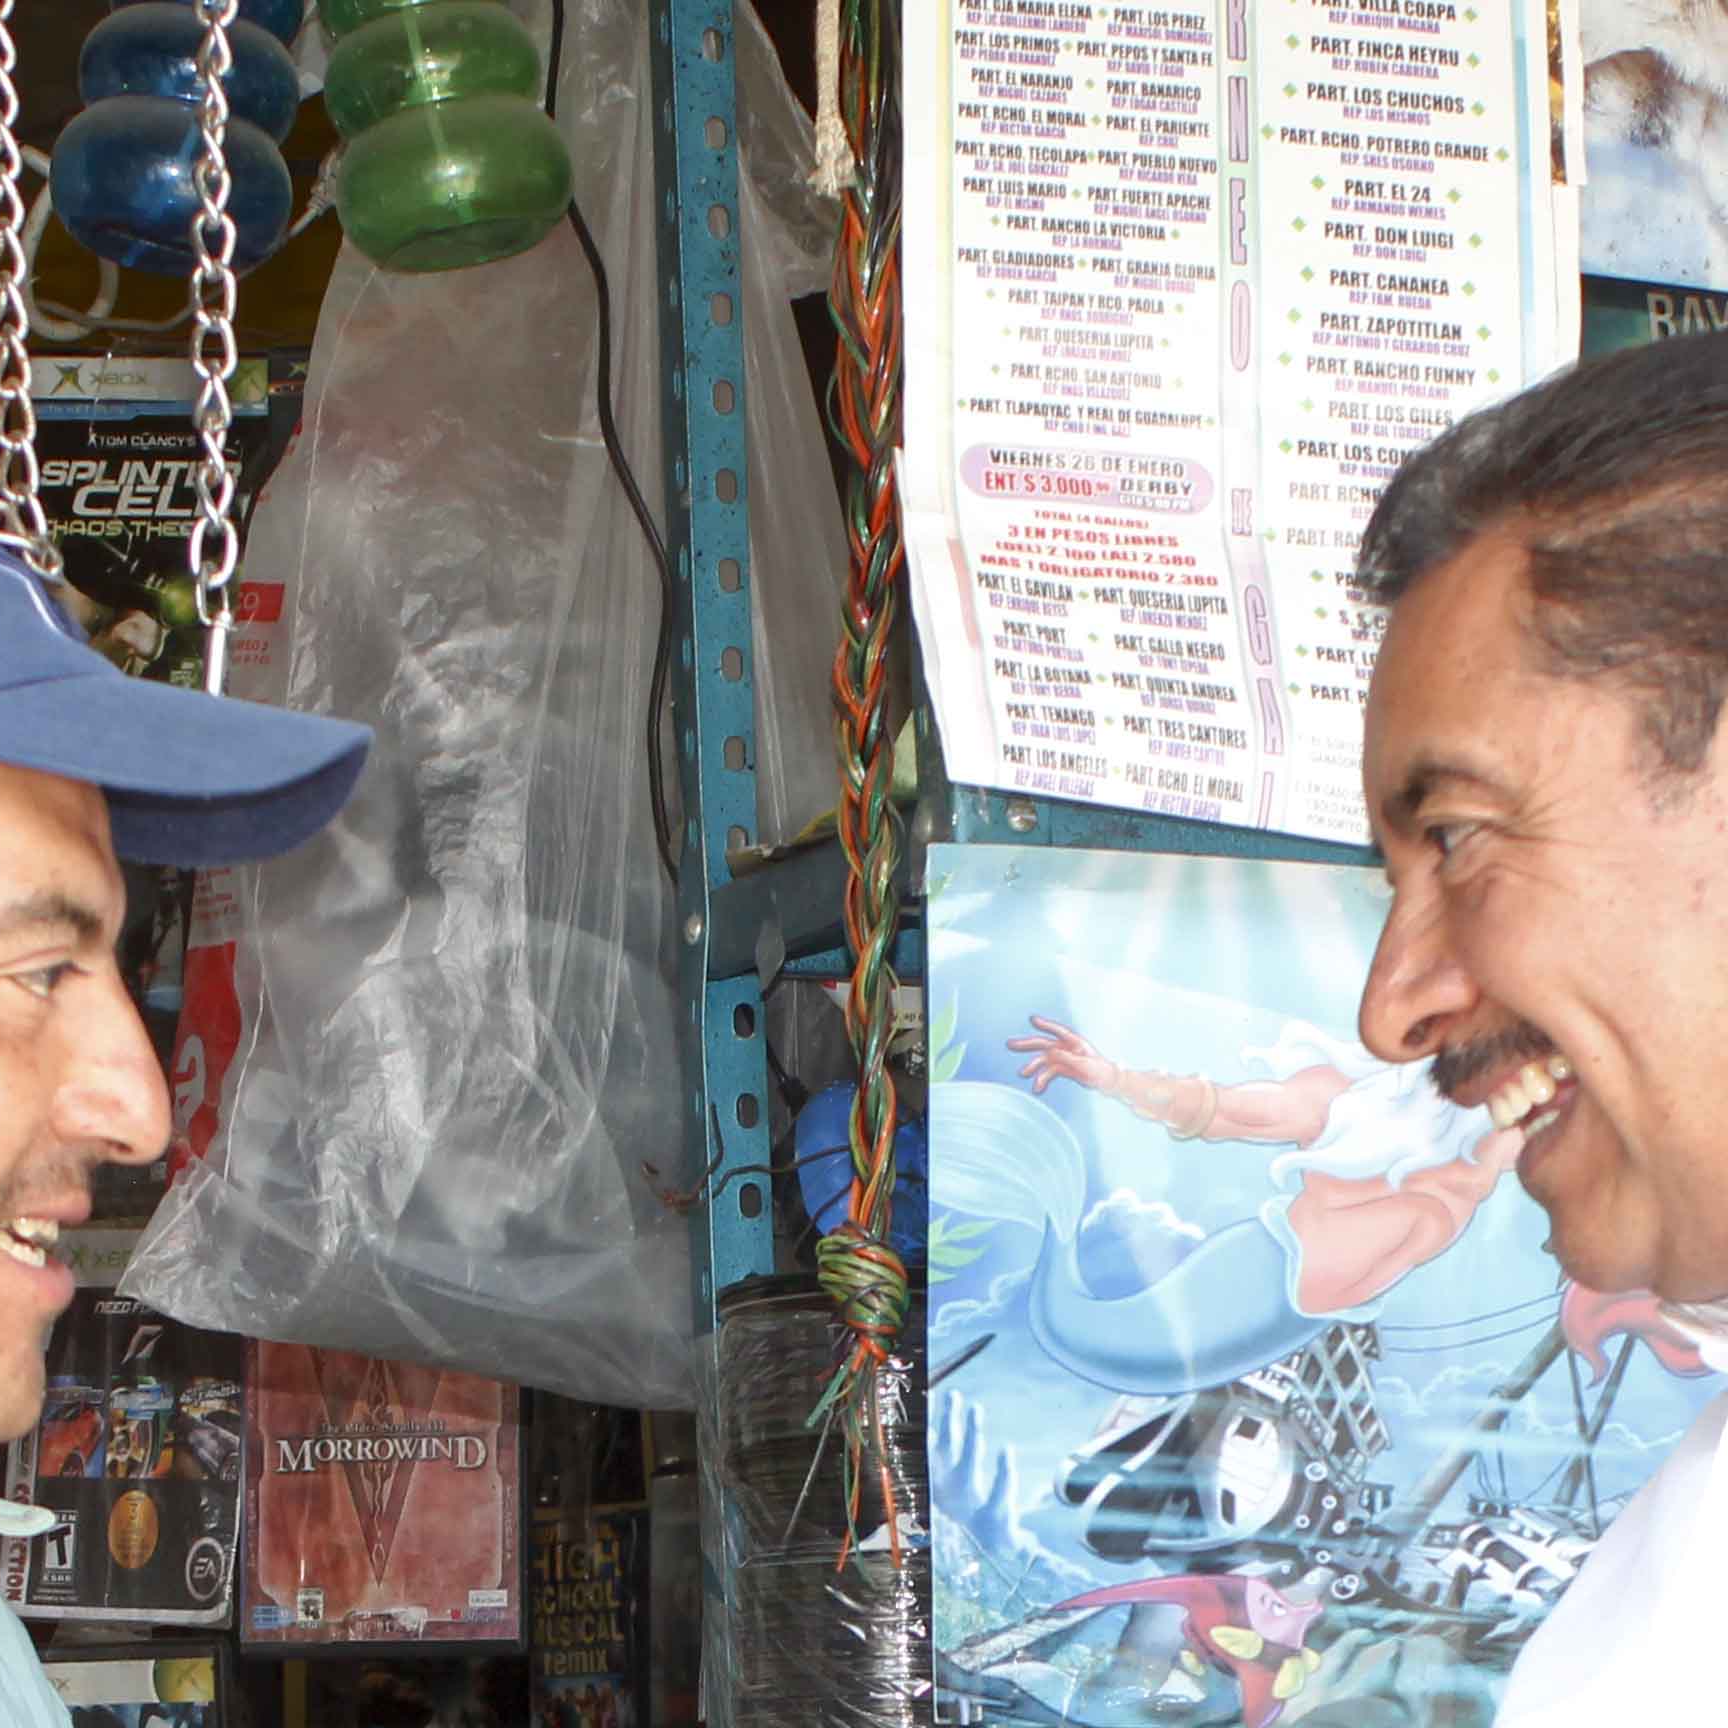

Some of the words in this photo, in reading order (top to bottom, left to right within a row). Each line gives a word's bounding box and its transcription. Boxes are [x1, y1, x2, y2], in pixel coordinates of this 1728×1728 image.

[989, 32, 1010, 48] LOS
[1014, 35, 1060, 52] PRIMOS
[1312, 36, 1354, 56] PART.
[1358, 41, 1405, 60] FINCA
[1112, 46, 1148, 61] PEPOS
[1152, 50, 1158, 62] Y
[1162, 49, 1198, 64] SANTA
[1006, 71, 1018, 85] EL
[1022, 72, 1072, 90] NARANJO
[1307, 82, 1349, 103] PART.
[1354, 86, 1382, 105] LOS
[1387, 90, 1464, 113] CHUCHOS
[1140, 118, 1154, 132] EL
[1156, 120, 1210, 137] PARIENTE
[1280, 127, 1317, 146] PART.
[1322, 133, 1363, 150] RCHO.
[1367, 136, 1430, 157] POTRERO
[1434, 142, 1488, 161] GRANDE
[1345, 180, 1387, 199] PART.
[1391, 184, 1408, 200] EL
[1411, 186, 1432, 202] 24
[1042, 218, 1090, 234] RANCHO
[1094, 222, 1108, 235] LA
[1110, 223, 1166, 239] VICTORIA
[1325, 222, 1367, 241] PART.
[1375, 227, 1407, 245] DON
[1412, 230, 1454, 249] LUIGI
[992, 252, 1074, 268] GLADIADORES
[1330, 270, 1372, 288] PART.
[1377, 273, 1449, 295] CANANEA
[1307, 355, 1349, 375] PART.
[1354, 359, 1420, 380] RANCHO
[1425, 366, 1475, 385] FUNNY
[990, 450, 1065, 468] VIERNES
[1102, 456, 1122, 472] DE
[1127, 458, 1184, 478] ENERO
[1121, 478, 1191, 495] DERBY
[1187, 641, 1225, 661] NEGRO
[1157, 719, 1185, 738] TRES
[1188, 723, 1247, 750] CANTORES
[276, 1436, 487, 1473] MORROWIND
